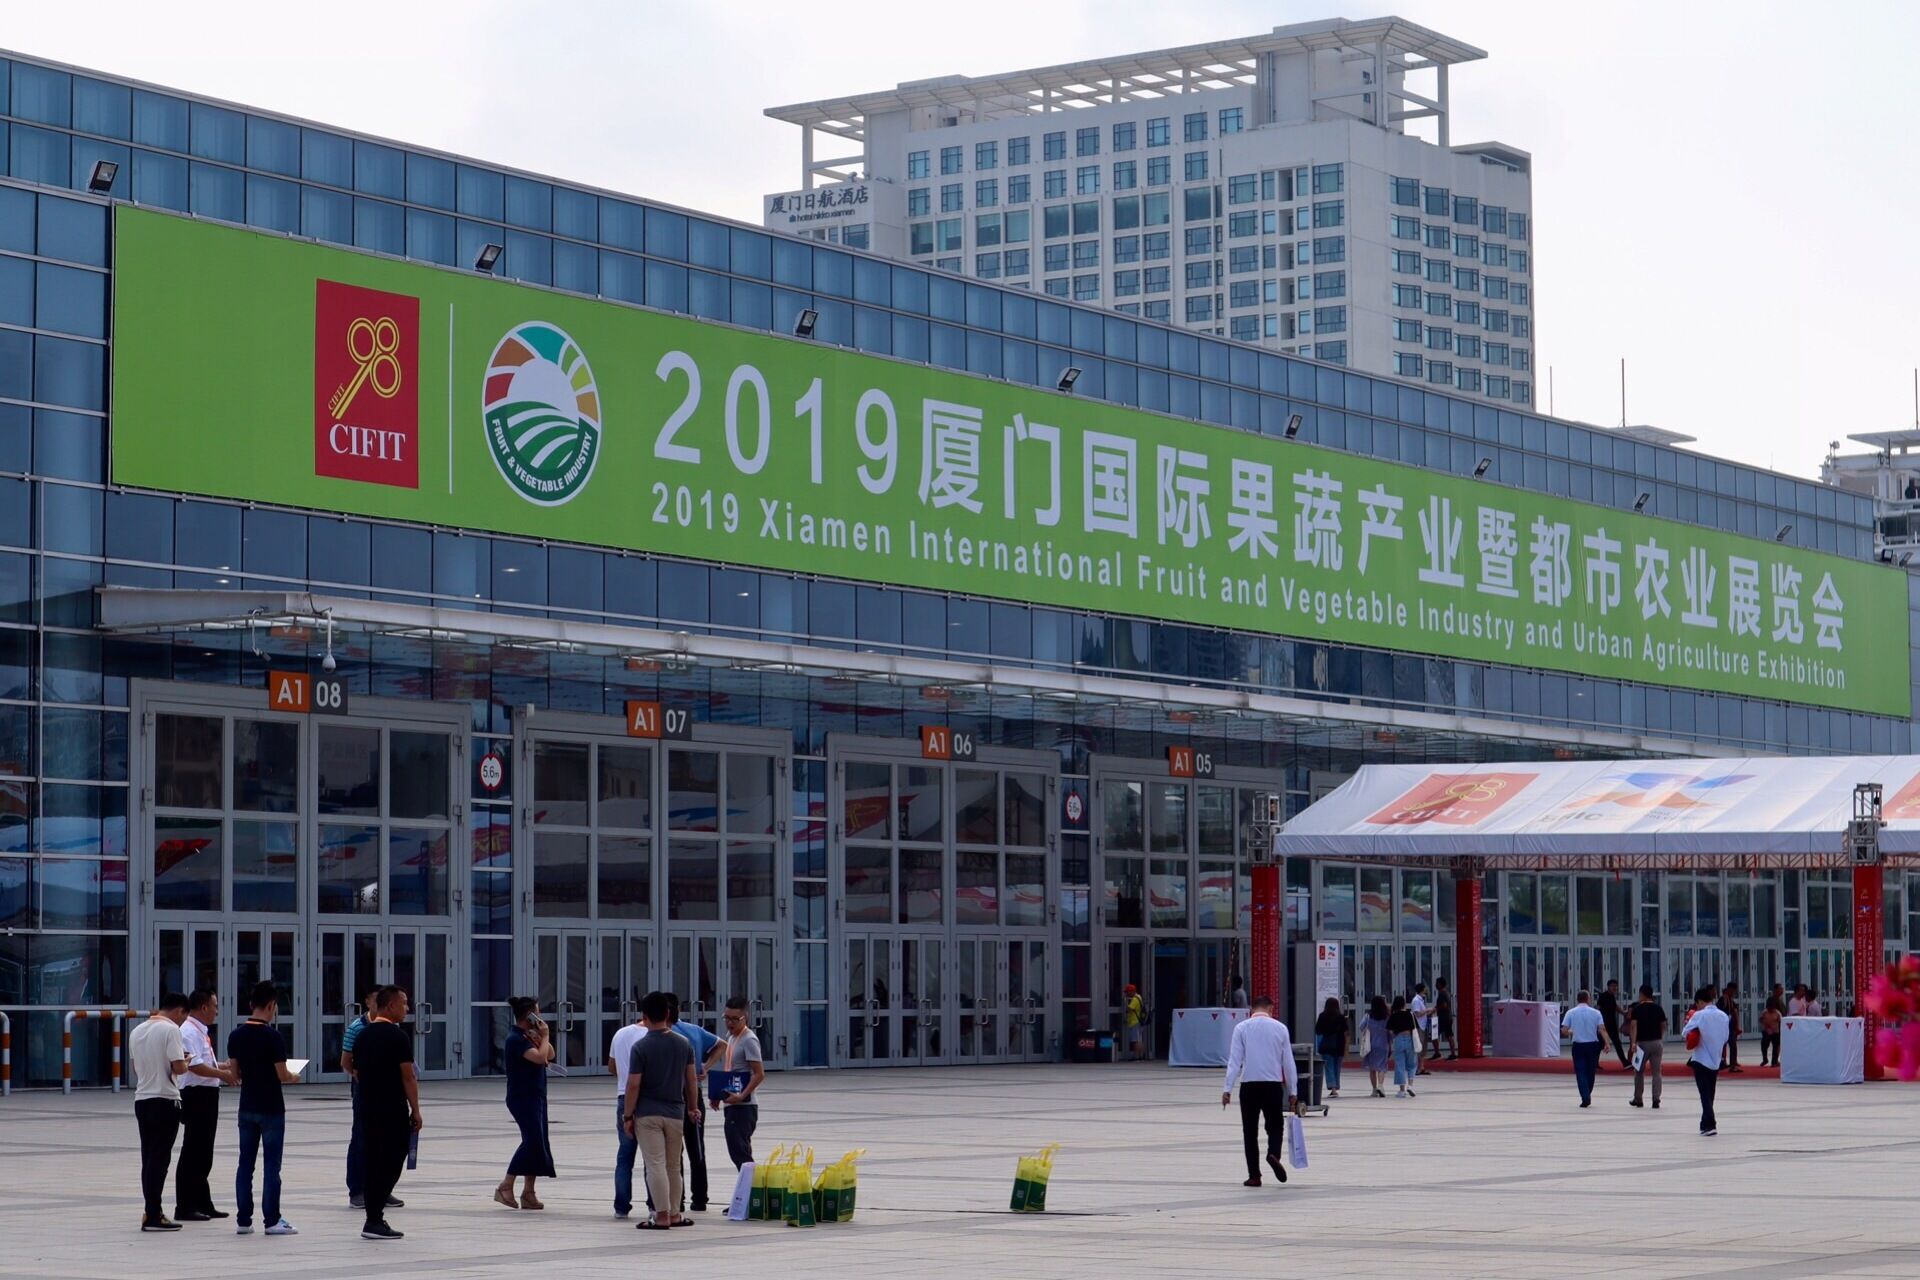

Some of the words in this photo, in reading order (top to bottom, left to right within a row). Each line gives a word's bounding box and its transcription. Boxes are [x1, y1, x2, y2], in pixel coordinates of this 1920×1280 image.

[770, 185, 869, 215] 厦门日航酒店
[329, 423, 405, 461] CIFIT
[491, 418, 511, 456] FRUIT
[506, 456, 516, 469] &
[514, 463, 565, 493] VEGETABLE
[564, 431, 593, 486] INDUSTRY
[652, 482, 739, 533] 2019
[759, 498, 891, 554] Xiamen
[910, 520, 1122, 587] International
[1138, 555, 1207, 599] Fruit
[1221, 574, 1267, 608] and
[1280, 577, 1408, 627] Vegetable
[1419, 598, 1514, 650] Industry
[1525, 619, 1563, 649] and
[1573, 622, 1632, 659] Urban
[1642, 633, 1749, 675] Agriculture
[1758, 650, 1845, 689] Exhibition
[277, 678, 302, 705] A1
[316, 681, 342, 708] 08
[634, 708, 655, 732] A1
[665, 709, 687, 734] 07
[928, 731, 946, 754] A1
[953, 735, 973, 756] 06
[482, 765, 500, 778] 5.6m
[1174, 752, 1190, 773] A1
[1196, 754, 1212, 774] 05
